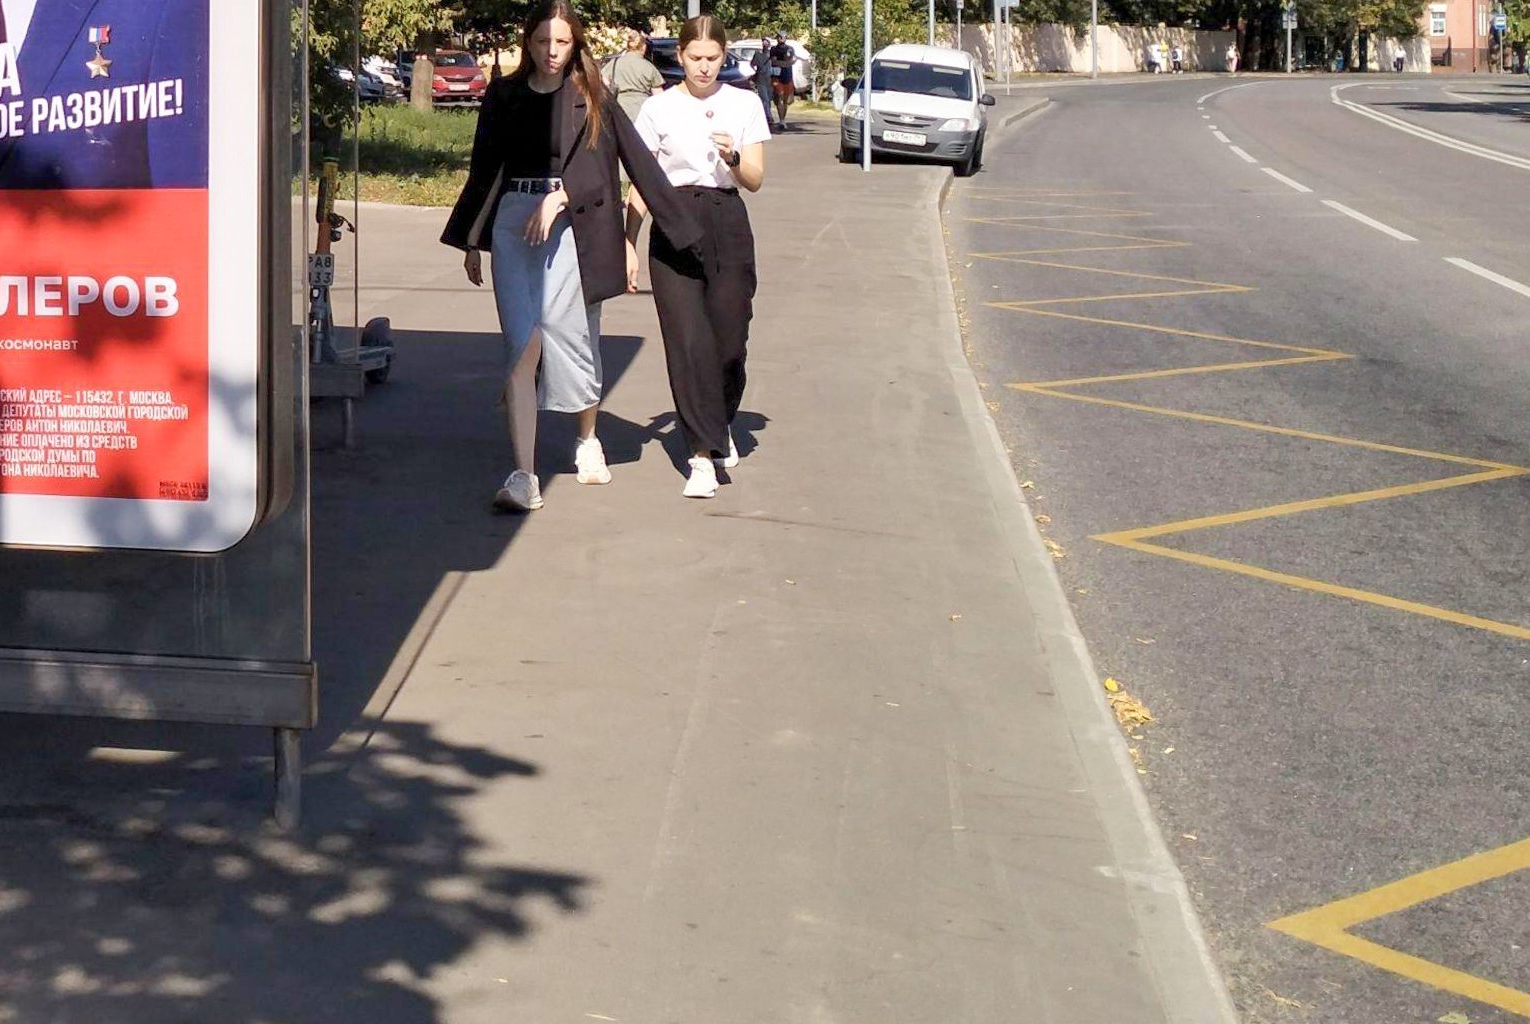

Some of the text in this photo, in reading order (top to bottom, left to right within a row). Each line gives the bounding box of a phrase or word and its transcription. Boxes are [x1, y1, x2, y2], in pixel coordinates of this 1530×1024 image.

[31, 78, 184, 136] РАЗВИТИЕ!
[308, 271, 331, 284] 33
[29, 389, 62, 404] АДРЕС
[3, 404, 56, 419] ДЕПУТАТЫ
[58, 404, 125, 418] МОСКОВСКОЙ
[128, 405, 188, 420] ГОРОДСКОЙ
[25, 419, 58, 433] АНТОН
[60, 420, 130, 434] НИКОЛАЕВИЧ.
[21, 434, 74, 448] ОПЛАЧЕНО
[76, 435, 90, 448] ИЗ
[92, 435, 138, 450] СРЕДСТВ
[47, 449, 80, 463] ДУМЫ
[81, 449, 96, 463] ПО
[23, 463, 99, 478] НИКОЛАЕВИЧА.
